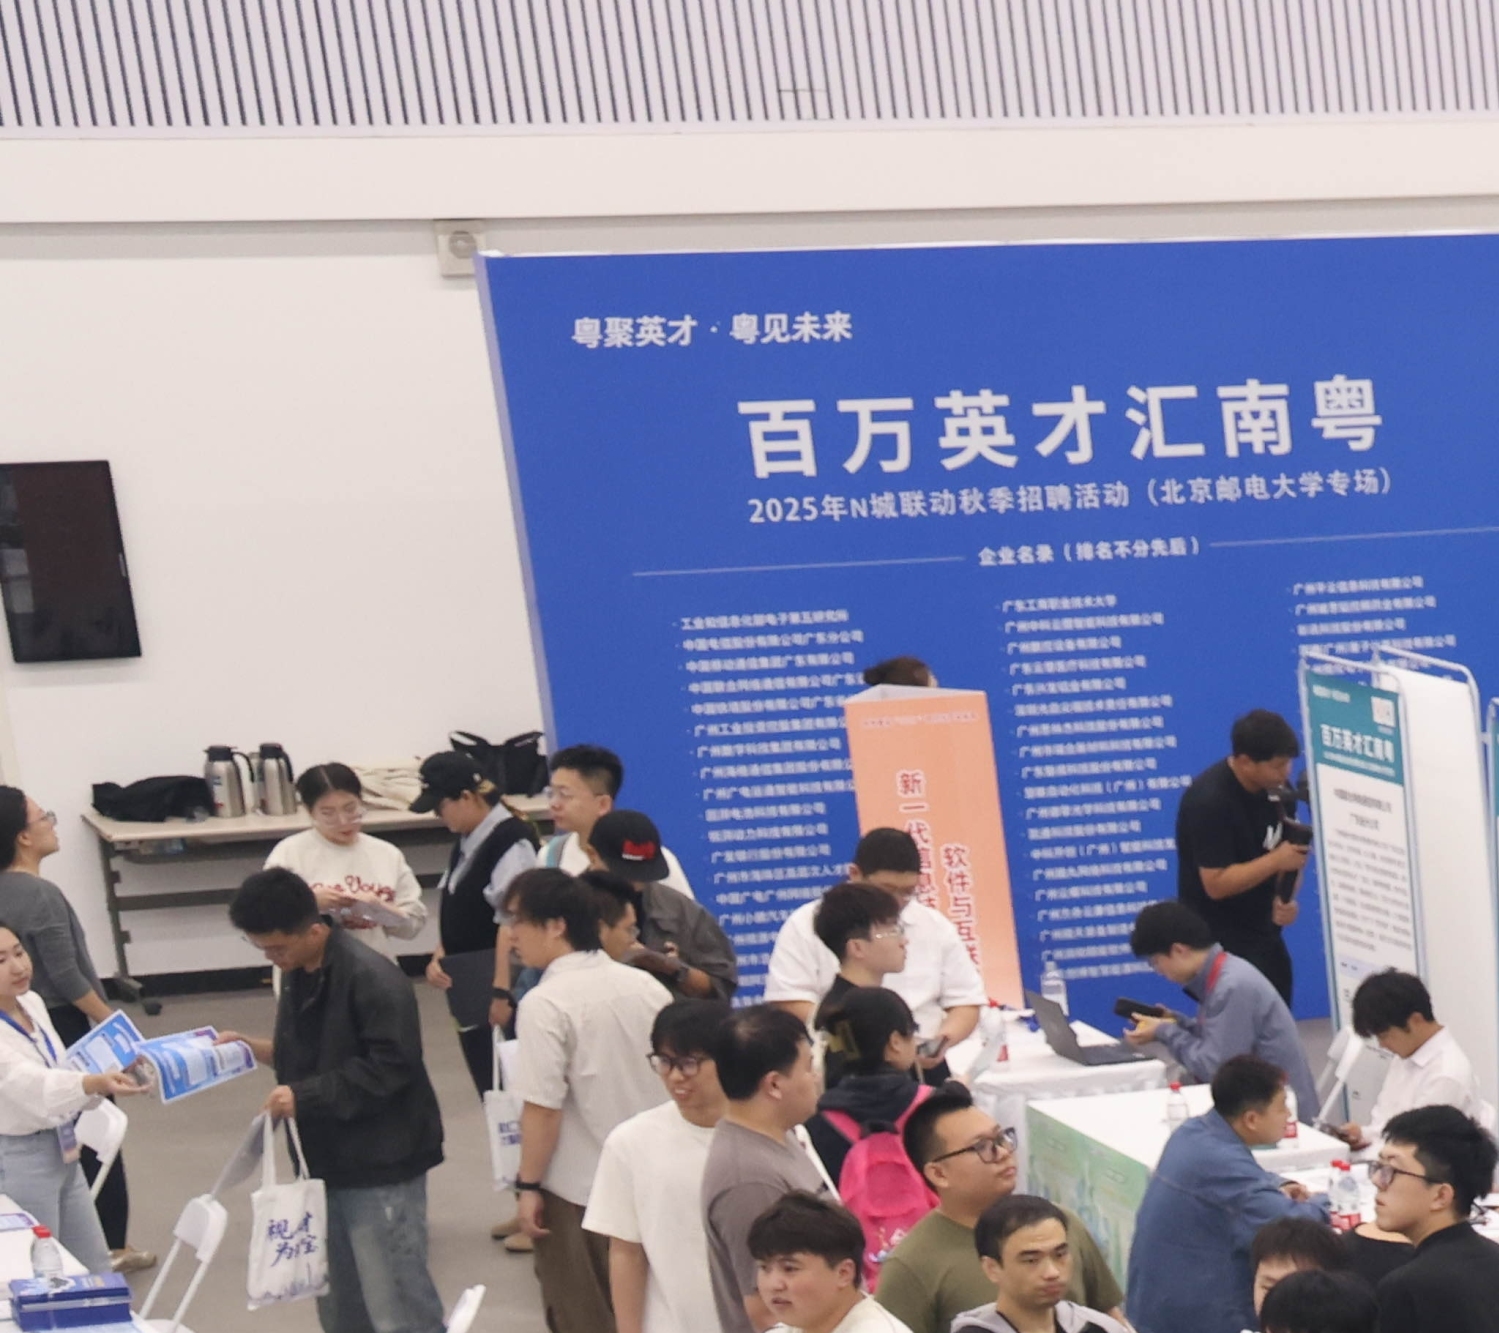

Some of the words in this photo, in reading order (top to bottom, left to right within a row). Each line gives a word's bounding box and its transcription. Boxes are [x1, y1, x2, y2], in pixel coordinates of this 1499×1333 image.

[737, 374, 1382, 478] 百万英才汇南粤
[748, 467, 1391, 524] 2025年N城联动秋季招聘活动（北京邮电大学专场）
